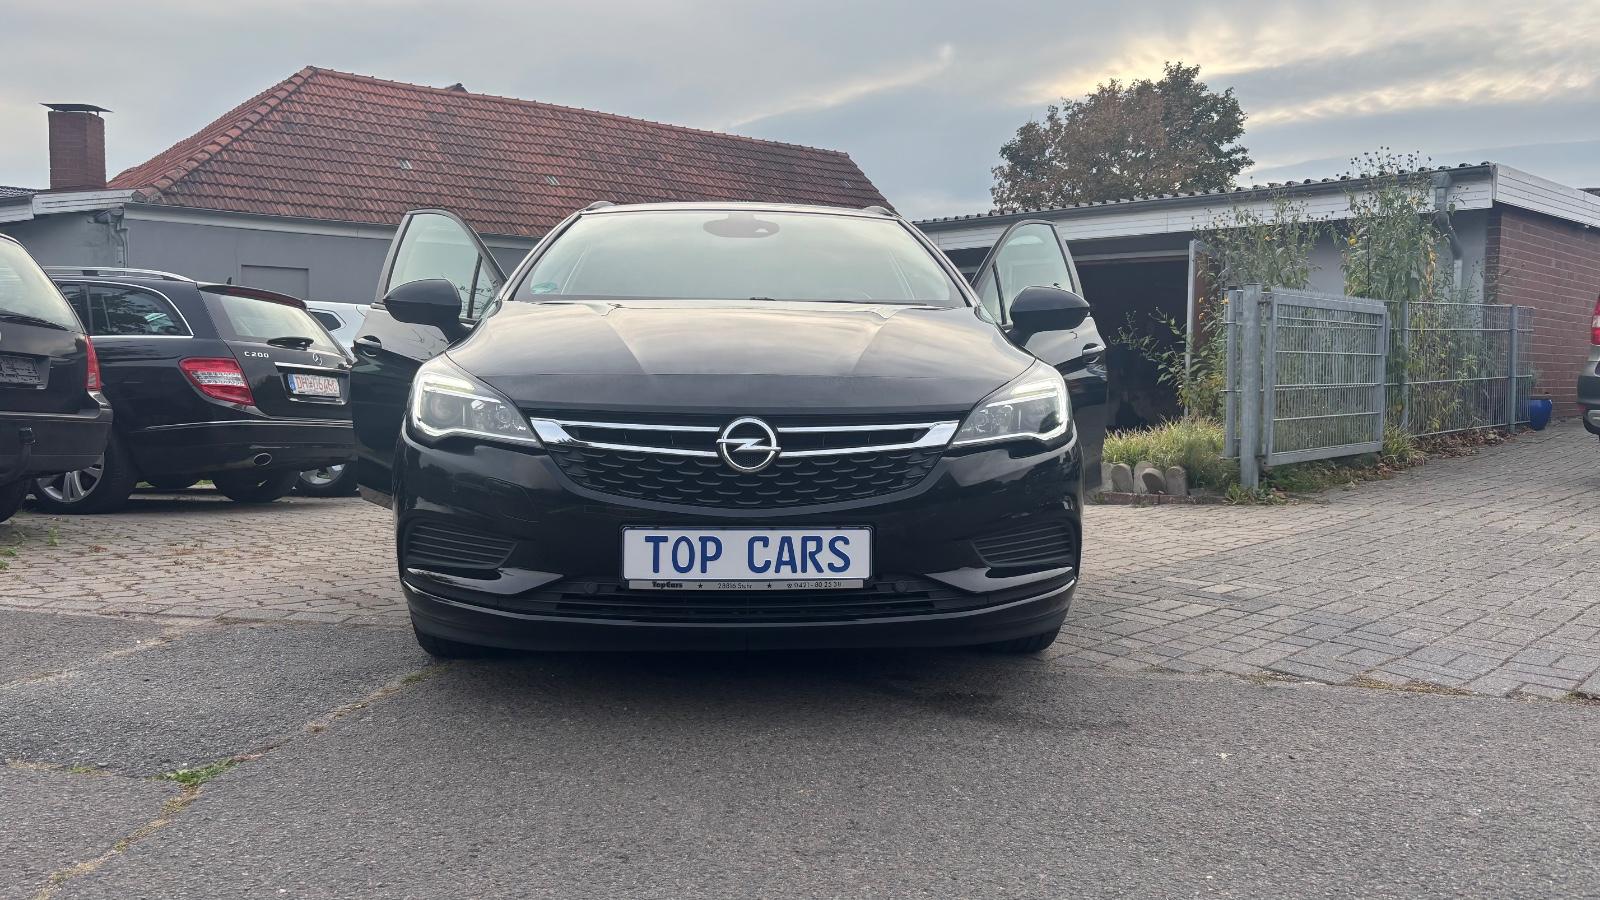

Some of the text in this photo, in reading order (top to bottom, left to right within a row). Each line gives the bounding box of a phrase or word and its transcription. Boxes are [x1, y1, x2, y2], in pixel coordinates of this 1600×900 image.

[645, 536, 851, 574] TOP CARS
[652, 581, 683, 589] TopCars
